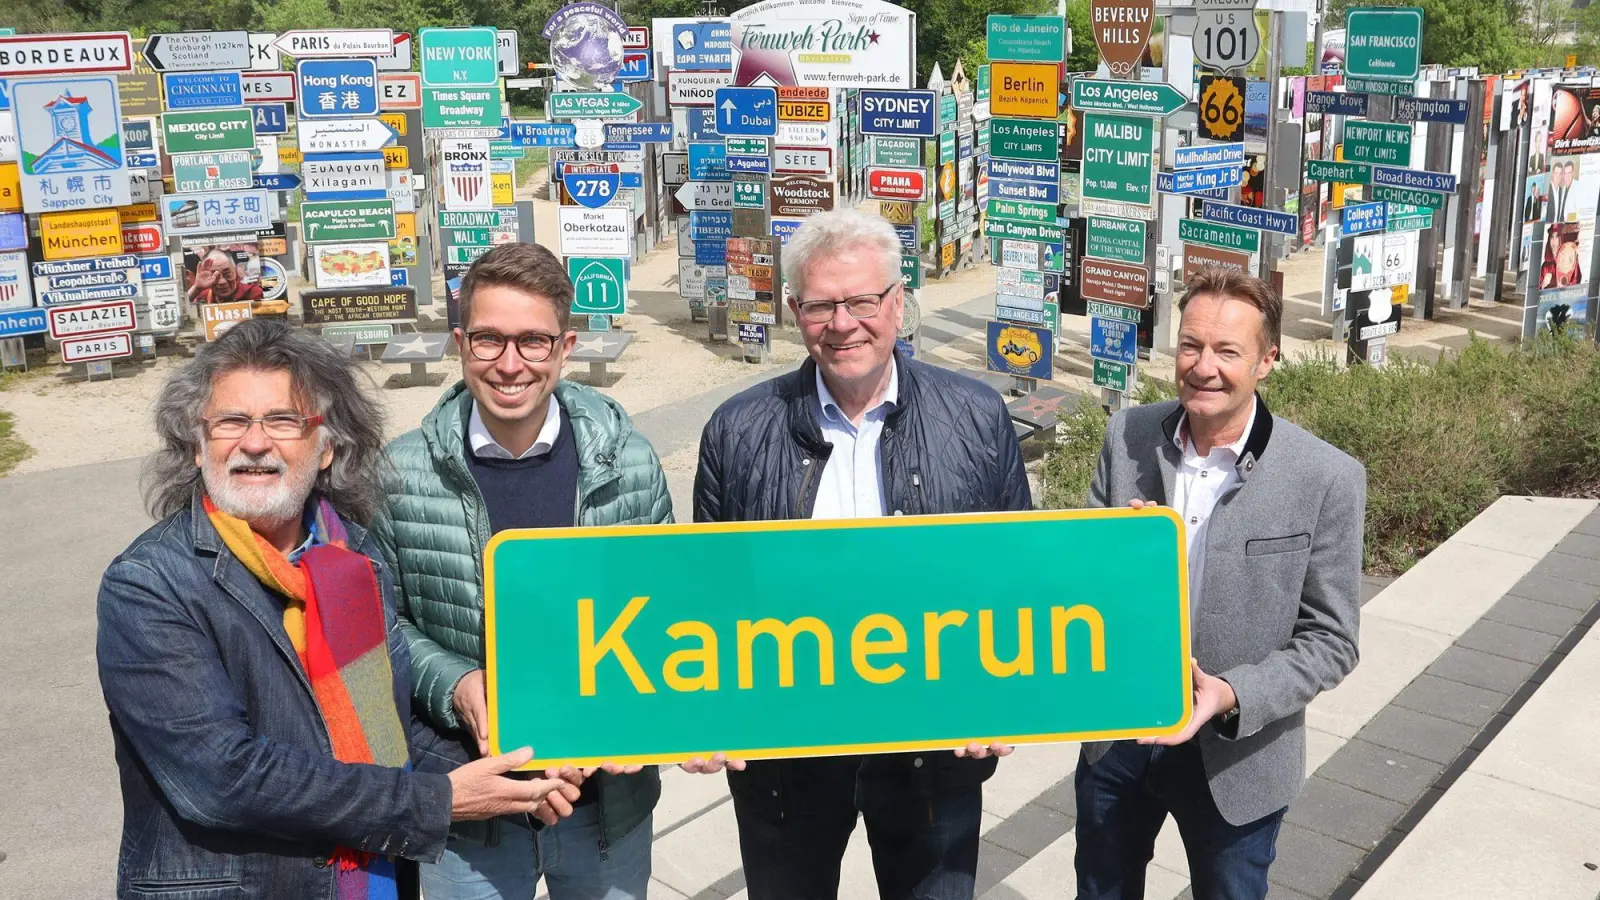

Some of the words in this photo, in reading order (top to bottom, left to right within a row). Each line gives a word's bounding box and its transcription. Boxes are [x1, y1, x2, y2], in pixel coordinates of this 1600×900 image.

[544, 21, 557, 36] For
[564, 6, 604, 18] peaceful
[605, 11, 626, 34] world
[1096, 7, 1149, 22] BEVERLY
[992, 23, 1006, 32] Rio
[1010, 24, 1020, 32] de
[1024, 24, 1059, 33] Janeiro
[741, 19, 871, 52] Fernweh-Park
[1103, 29, 1139, 43] HILLS
[1351, 36, 1366, 46] SAN
[1369, 36, 1416, 48] FRANCISCO
[293, 37, 330, 50] PARIS
[1204, 28, 1247, 60] 101
[0, 47, 120, 65] BORDEAUX
[426, 47, 454, 60] NEW
[460, 47, 492, 60] YORK
[1368, 59, 1395, 68] California
[304, 75, 337, 88] Hong
[341, 74, 373, 87] Kong
[804, 72, 900, 83] www.fernweh-park.de
[1004, 77, 1044, 91] Berlin
[171, 83, 236, 94] CINCINNATI
[1080, 84, 1100, 97] Los
[1104, 85, 1158, 102] Angeles
[318, 91, 360, 110] 香港
[432, 91, 457, 101] Times
[460, 91, 490, 102] Square
[999, 95, 1017, 103] Bezirk
[1020, 96, 1048, 104] Köpenick
[1306, 92, 1335, 108] Orange
[1340, 94, 1363, 106] Grove
[440, 106, 484, 116] Broadway
[754, 99, 771, 111] دبي
[778, 106, 824, 117] TUBIZE
[864, 98, 930, 113] SYDNEY
[1204, 91, 1239, 126] 66
[1399, 100, 1450, 118] Washington
[169, 123, 216, 133] MEXICO
[220, 120, 248, 130] CITY
[742, 115, 772, 125] Dubai
[874, 118, 894, 127] CITY
[897, 119, 920, 129] LIMIT
[525, 126, 571, 137] Broadway
[608, 127, 653, 135] Tennessee
[993, 125, 1010, 134] Los
[1013, 126, 1055, 138] Angeles
[1095, 123, 1142, 141] MALIBU
[1346, 126, 1382, 142] NEWPORT
[1385, 129, 1409, 144] NEWS
[310, 141, 367, 149] MONASTIR
[878, 140, 916, 150] CAÇADOR
[1004, 142, 1018, 150] CITY
[1021, 143, 1042, 152] LIMITS
[174, 155, 216, 166] PORTLAND,
[219, 154, 248, 164] OREGON
[444, 152, 488, 161] BRONX
[1086, 148, 1112, 163] CITY
[1117, 151, 1149, 167] LIMIT
[1224, 149, 1241, 159] Drive
[1355, 146, 1370, 157] CITY
[1374, 148, 1397, 160] LIMITS
[310, 162, 379, 174] Ξυλαγανή
[992, 162, 1034, 176] Hollywood
[1037, 165, 1055, 177] Blvd
[1311, 164, 1353, 179] Capehart
[40, 175, 111, 195] 札幌市
[181, 181, 200, 190] CITY
[204, 180, 214, 188] OF
[219, 178, 247, 187] ROSES
[312, 177, 372, 188] Xilagani
[881, 176, 910, 186] PRAHA
[1197, 173, 1216, 187] King
[1219, 170, 1229, 183] Jr
[1231, 169, 1238, 181] Bl
[1376, 170, 1403, 184] Broad
[1405, 173, 1433, 188] Beach
[1436, 177, 1451, 189] SW
[576, 180, 610, 196] 278
[773, 187, 830, 198] Woodstock
[999, 184, 1027, 196] Sunset
[1029, 186, 1047, 198] Blvd
[42, 198, 86, 209] Sapporo
[93, 195, 113, 205] City
[1384, 188, 1429, 205] CHICAGO
[204, 196, 260, 216] 内子町
[305, 209, 356, 218] ACAPULCO
[359, 207, 391, 215] BEACH
[996, 203, 1018, 214] Palm
[1017, 205, 1048, 219] Springs
[1348, 208, 1373, 220] College
[1376, 205, 1383, 216] St
[50, 218, 112, 230] Landeshauptstadt
[205, 215, 235, 227] Uchiko
[239, 215, 263, 224] Stadt
[443, 213, 494, 225] BROADWAY
[583, 213, 605, 221] Markt
[1206, 205, 1234, 219] Pacific
[1237, 211, 1262, 226] Coast
[1266, 215, 1287, 232] Hwy
[564, 223, 625, 233] Oberkotzau
[984, 222, 1004, 233] Palm
[1006, 223, 1037, 238] Canyon
[1039, 227, 1061, 238] Drive
[1092, 219, 1127, 232] BURBANK
[1129, 224, 1140, 233] CA
[454, 231, 478, 243] WALL
[1181, 223, 1242, 245] Sacramento
[48, 234, 118, 249] München
[1091, 235, 1111, 244] MEDIA
[1113, 238, 1140, 248] CAPITAL
[38, 262, 91, 274] Münchner
[96, 257, 135, 270] Freiheit
[1386, 254, 1400, 267] 66
[52, 272, 124, 288] Leopoldstraße
[580, 274, 613, 282] CALIFORNIA
[1085, 266, 1111, 277] GRAND
[1114, 271, 1145, 282] CANYON
[47, 286, 132, 303] Viktualienmarkt
[587, 282, 607, 303] 11
[311, 298, 336, 308] CAPE
[341, 297, 352, 306] OF
[356, 296, 379, 305] GOOD
[384, 294, 407, 304] HOPE
[58, 307, 127, 324] SALAZIE
[206, 307, 250, 321] Lhasa
[1013, 311, 1038, 321] ANGELES
[1091, 303, 1122, 319] SELIGMAN
[1098, 320, 1130, 332] BRADENTON
[1102, 328, 1125, 340] FLORIDA
[77, 342, 117, 354] PARIS
[1100, 362, 1121, 372] Welcome
[577, 596, 1107, 697] Kamerun
